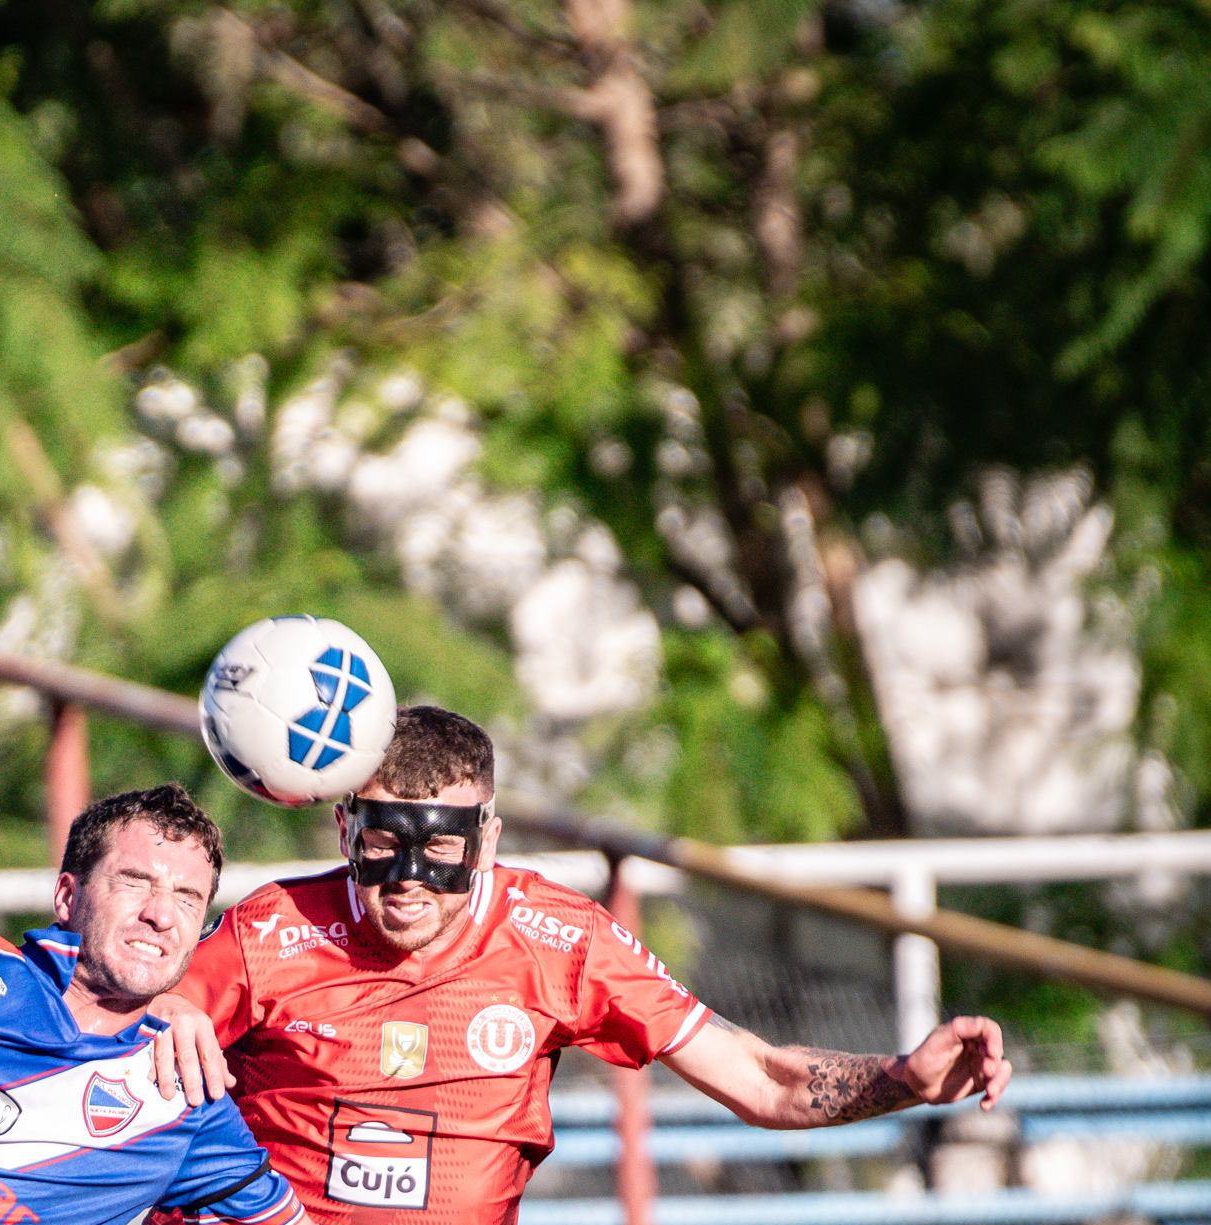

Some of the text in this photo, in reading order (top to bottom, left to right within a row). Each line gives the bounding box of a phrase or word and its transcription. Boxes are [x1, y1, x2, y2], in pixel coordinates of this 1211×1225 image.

[279, 939, 317, 959] CENTRO
[540, 933, 572, 952] SALTO
[487, 1021, 516, 1056] U
[340, 1160, 416, 1199] Cujó
